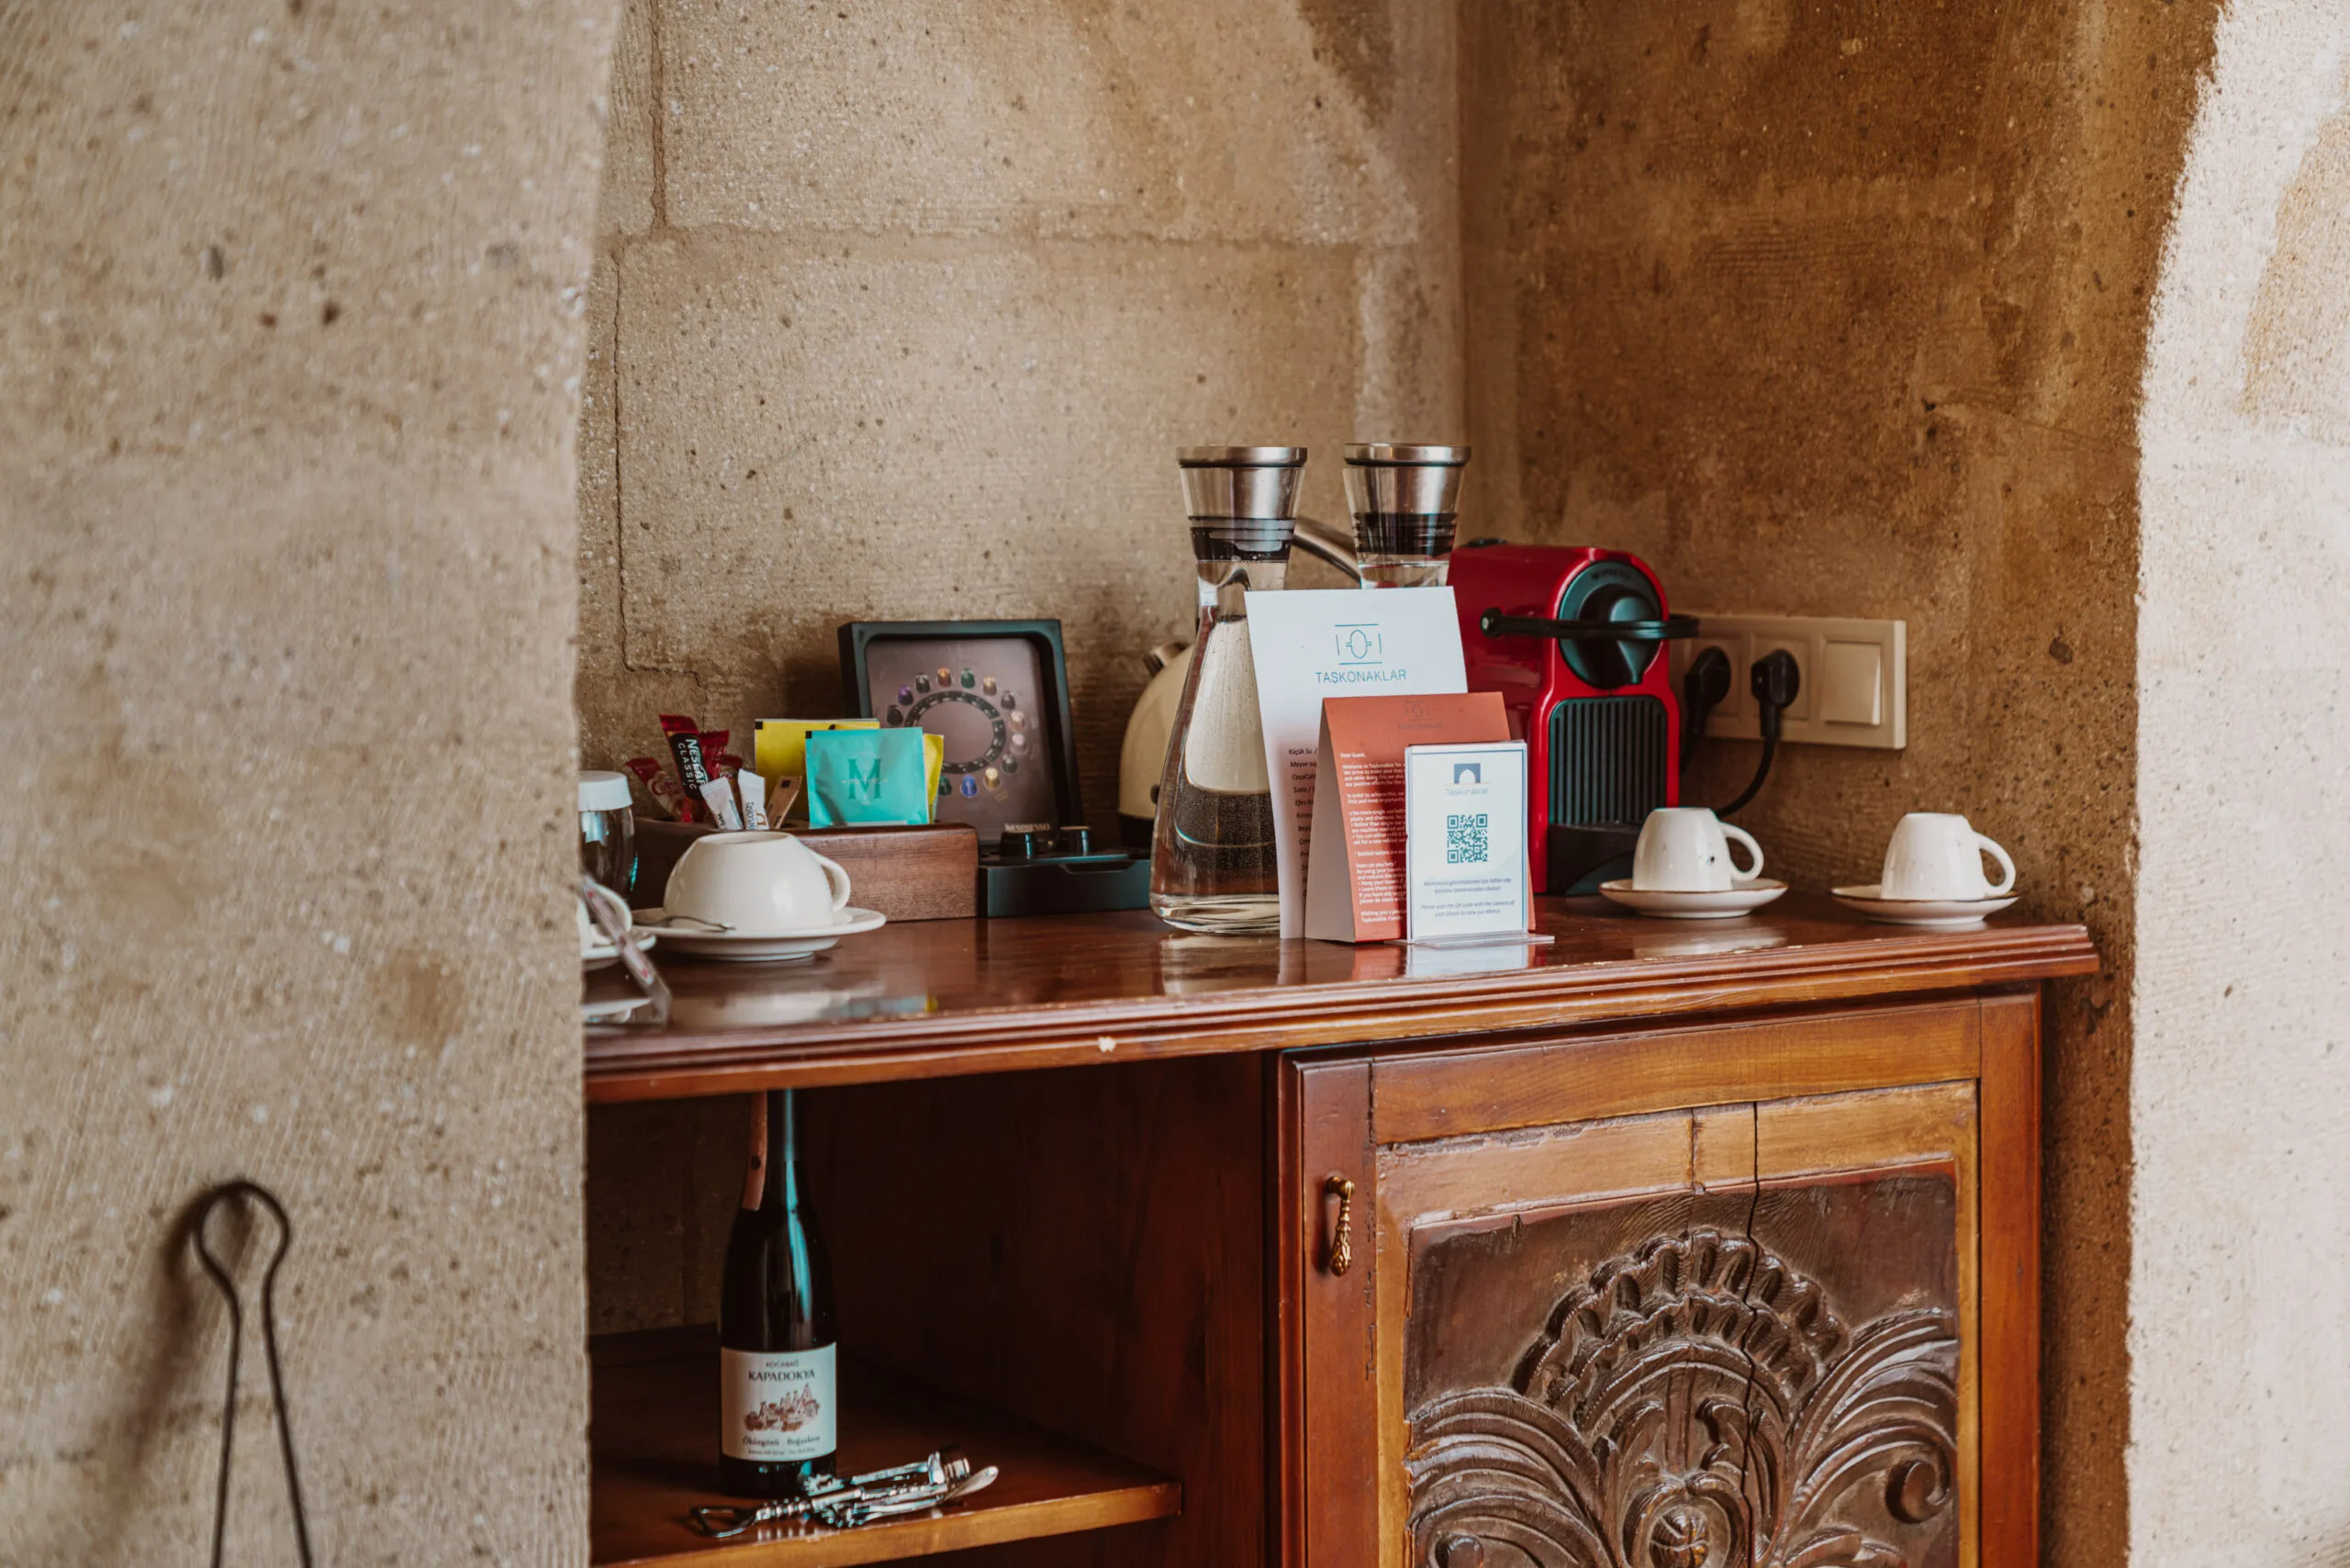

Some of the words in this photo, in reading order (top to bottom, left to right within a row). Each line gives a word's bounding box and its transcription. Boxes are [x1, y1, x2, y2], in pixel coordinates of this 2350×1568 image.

[677, 742, 697, 790] CLASSIC
[685, 739, 706, 786] NESCAF
[847, 758, 881, 800] M
[748, 1369, 815, 1381] KAPADOKYA
